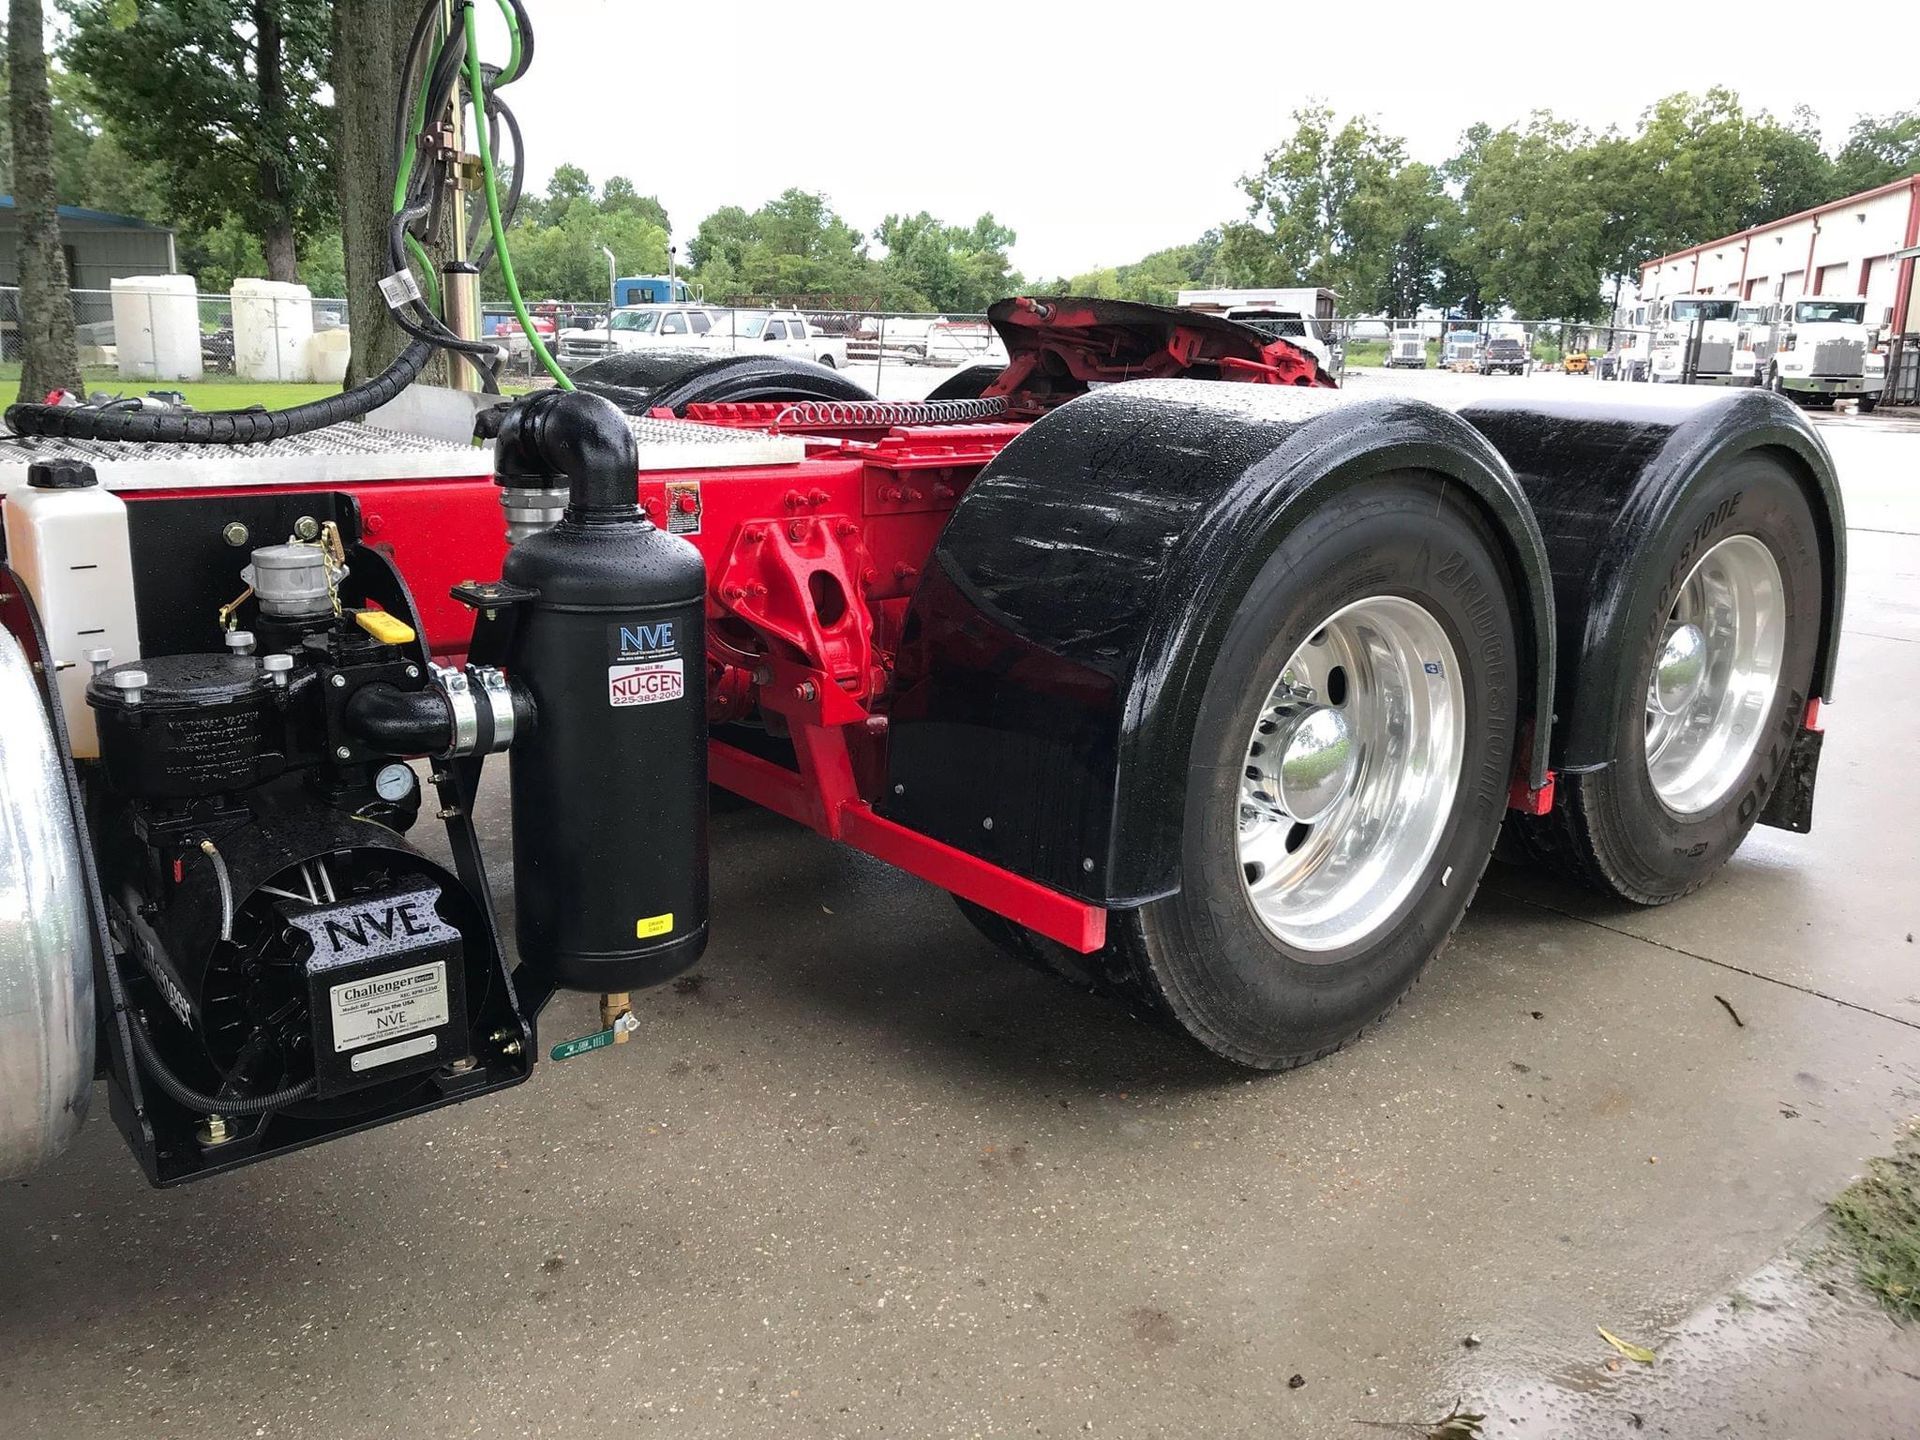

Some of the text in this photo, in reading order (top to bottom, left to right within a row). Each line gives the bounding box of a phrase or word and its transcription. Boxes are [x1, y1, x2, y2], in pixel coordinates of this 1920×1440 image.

[619, 622, 675, 651] NVE
[612, 675, 682, 697] NU-GEN
[613, 690, 682, 704] 225-382-2006
[323, 902, 430, 953] NVE
[344, 976, 414, 1000] Challenger
[367, 1007, 383, 1015] Made
[402, 999, 415, 1007] USA
[376, 1011, 407, 1029] NVE
